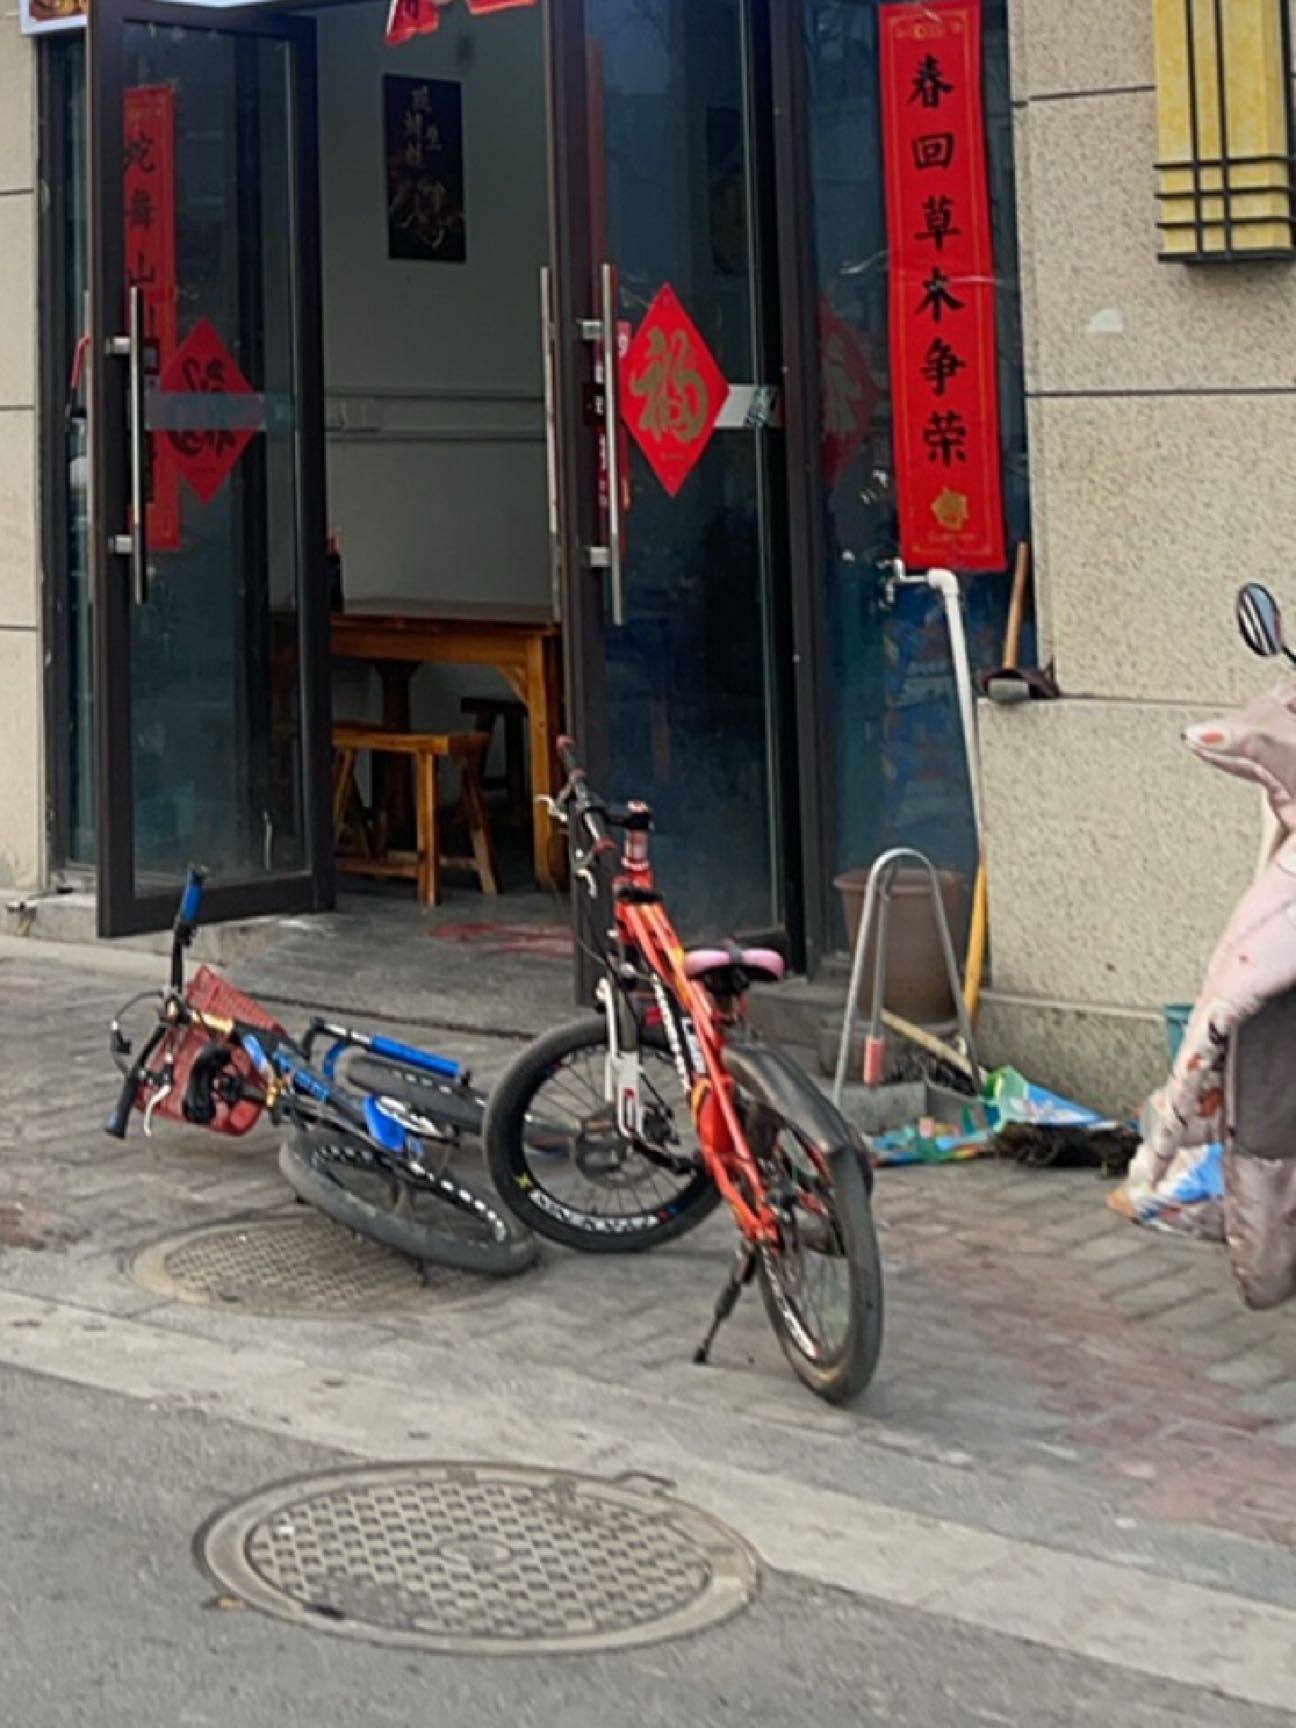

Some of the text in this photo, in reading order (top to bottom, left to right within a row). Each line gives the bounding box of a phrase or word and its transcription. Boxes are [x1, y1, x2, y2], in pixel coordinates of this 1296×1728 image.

[628, 325, 710, 444] 福
[907, 52, 969, 469] 春回草木争荣
